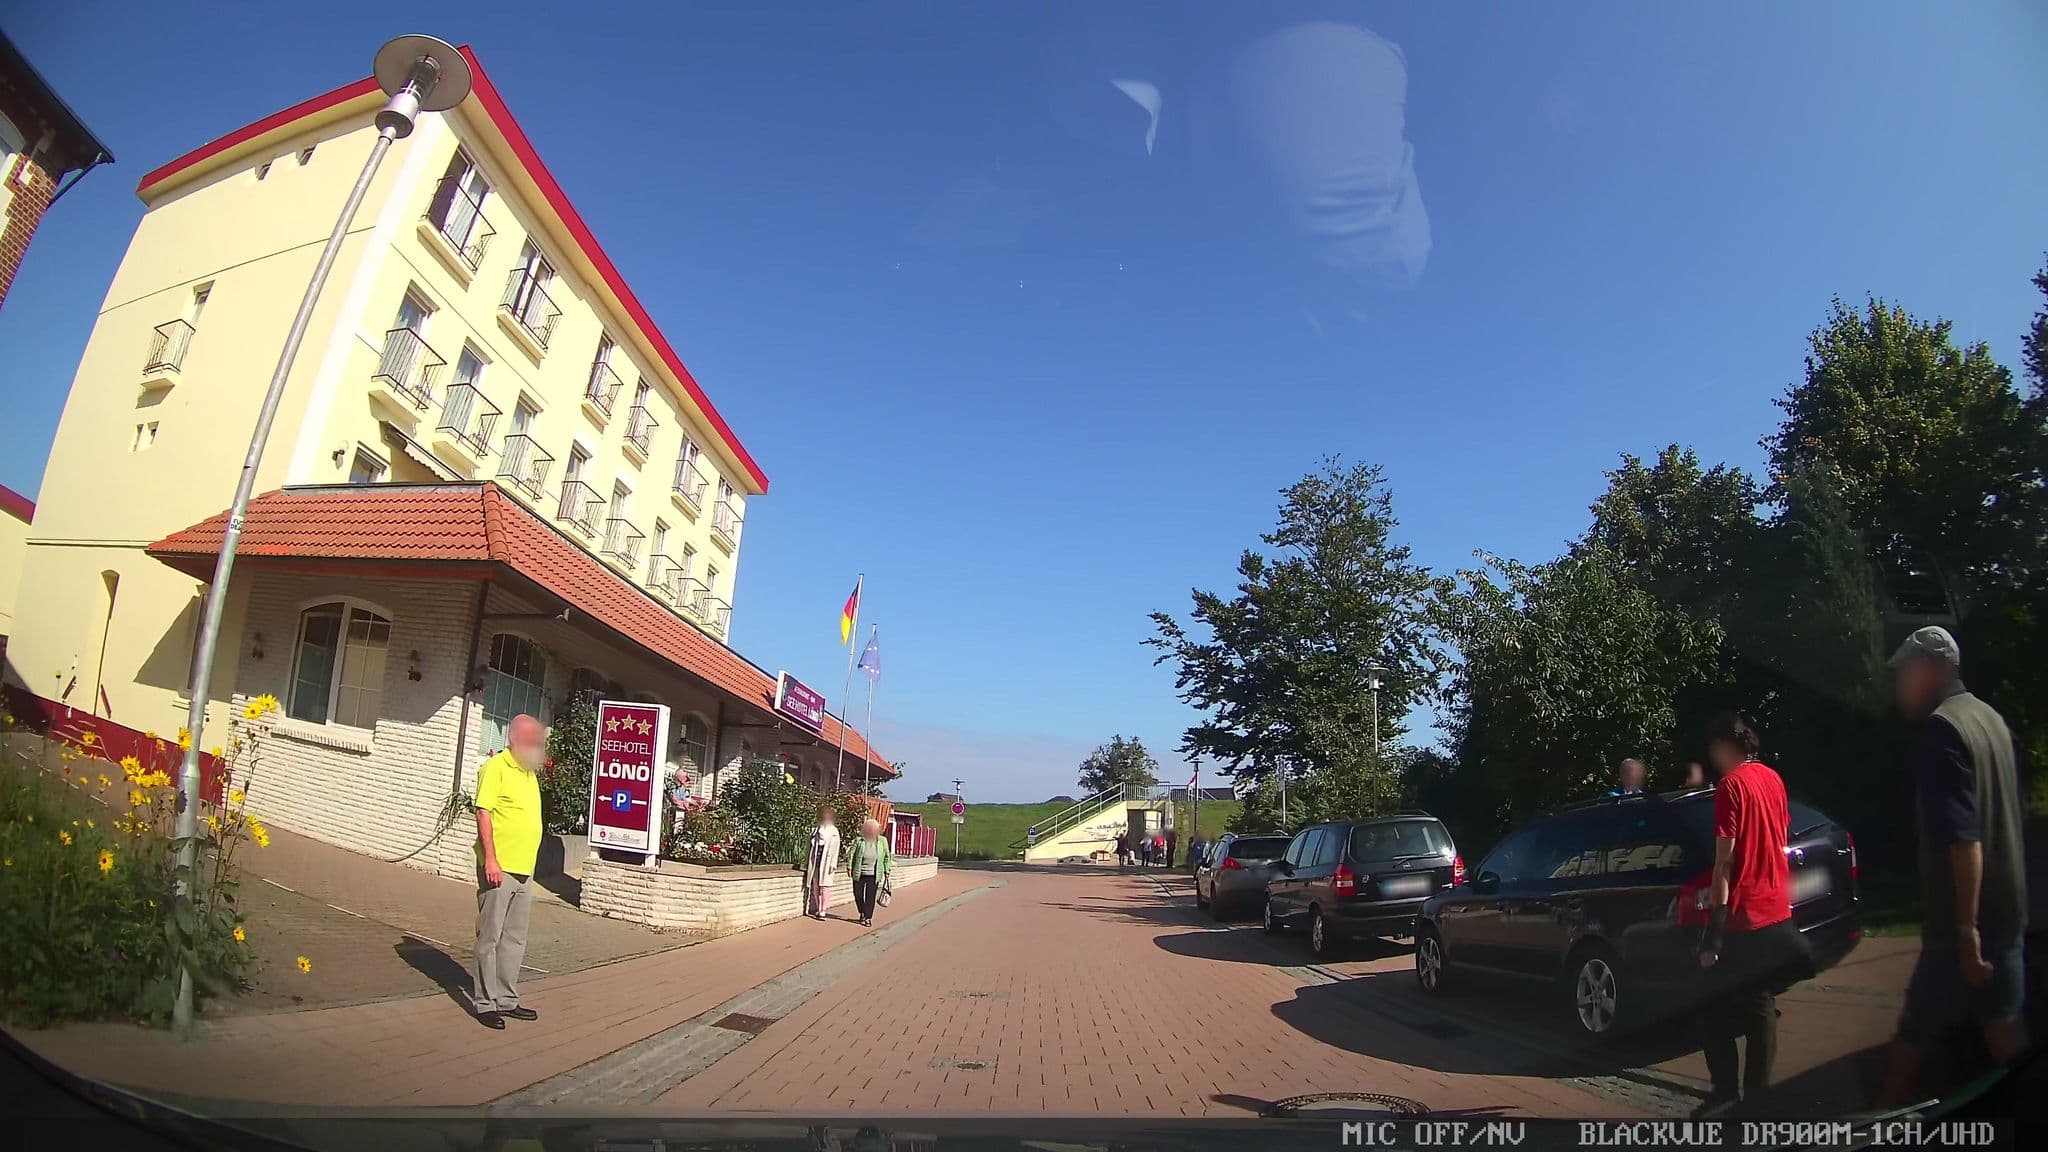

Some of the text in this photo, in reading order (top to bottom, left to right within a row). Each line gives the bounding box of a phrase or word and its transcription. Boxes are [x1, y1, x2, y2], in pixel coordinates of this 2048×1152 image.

[601, 739, 652, 755] SEEHOTEL
[598, 758, 650, 782] LÖNÖ
[616, 792, 627, 808] P
